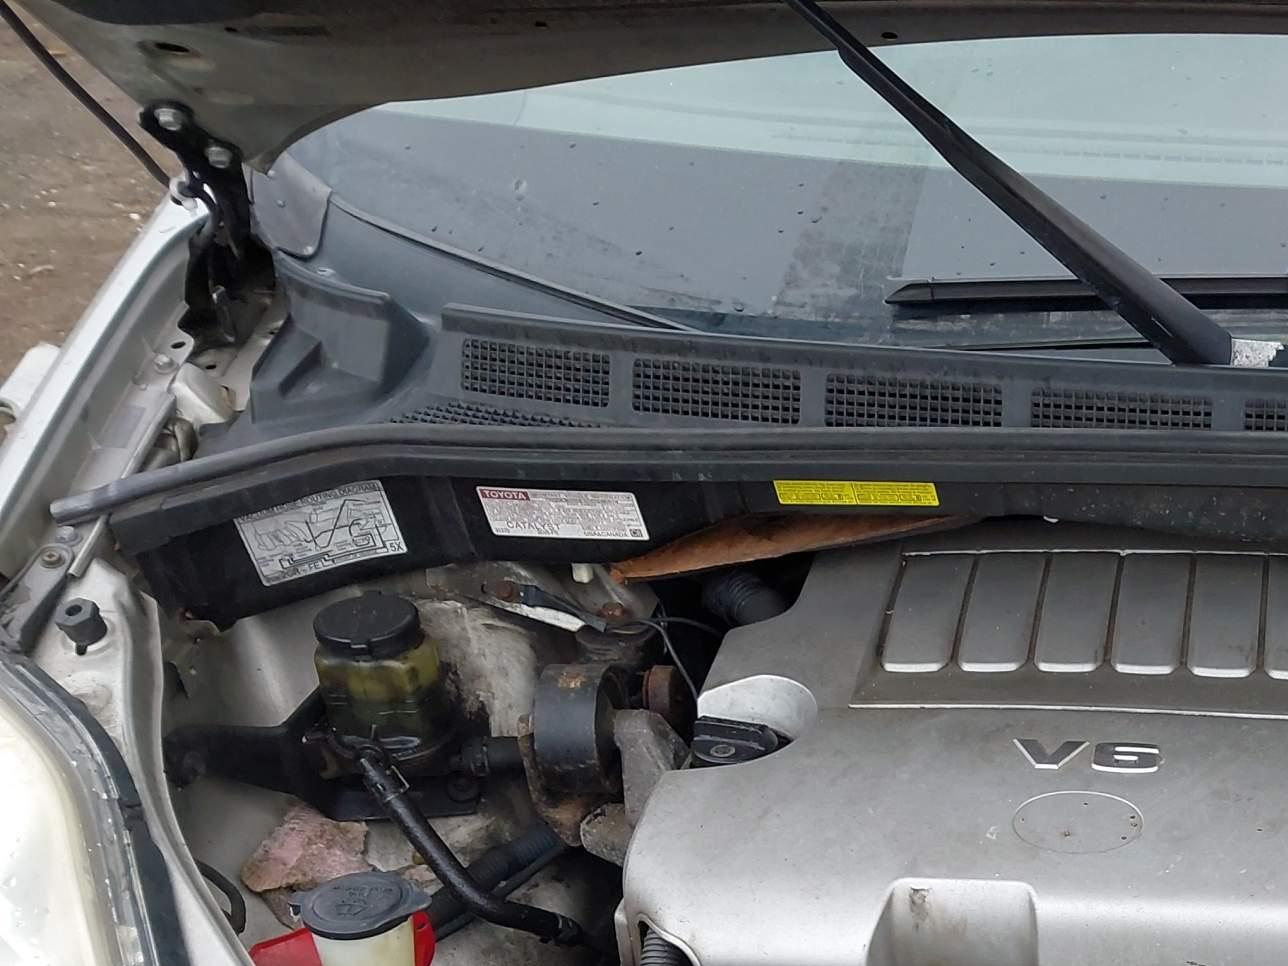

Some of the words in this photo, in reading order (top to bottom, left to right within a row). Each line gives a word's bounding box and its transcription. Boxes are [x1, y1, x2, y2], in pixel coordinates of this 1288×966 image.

[483, 489, 528, 500] TOYOTA
[506, 520, 561, 531] CATALYST
[391, 540, 403, 553] 5X
[1012, 738, 1161, 774] V6
